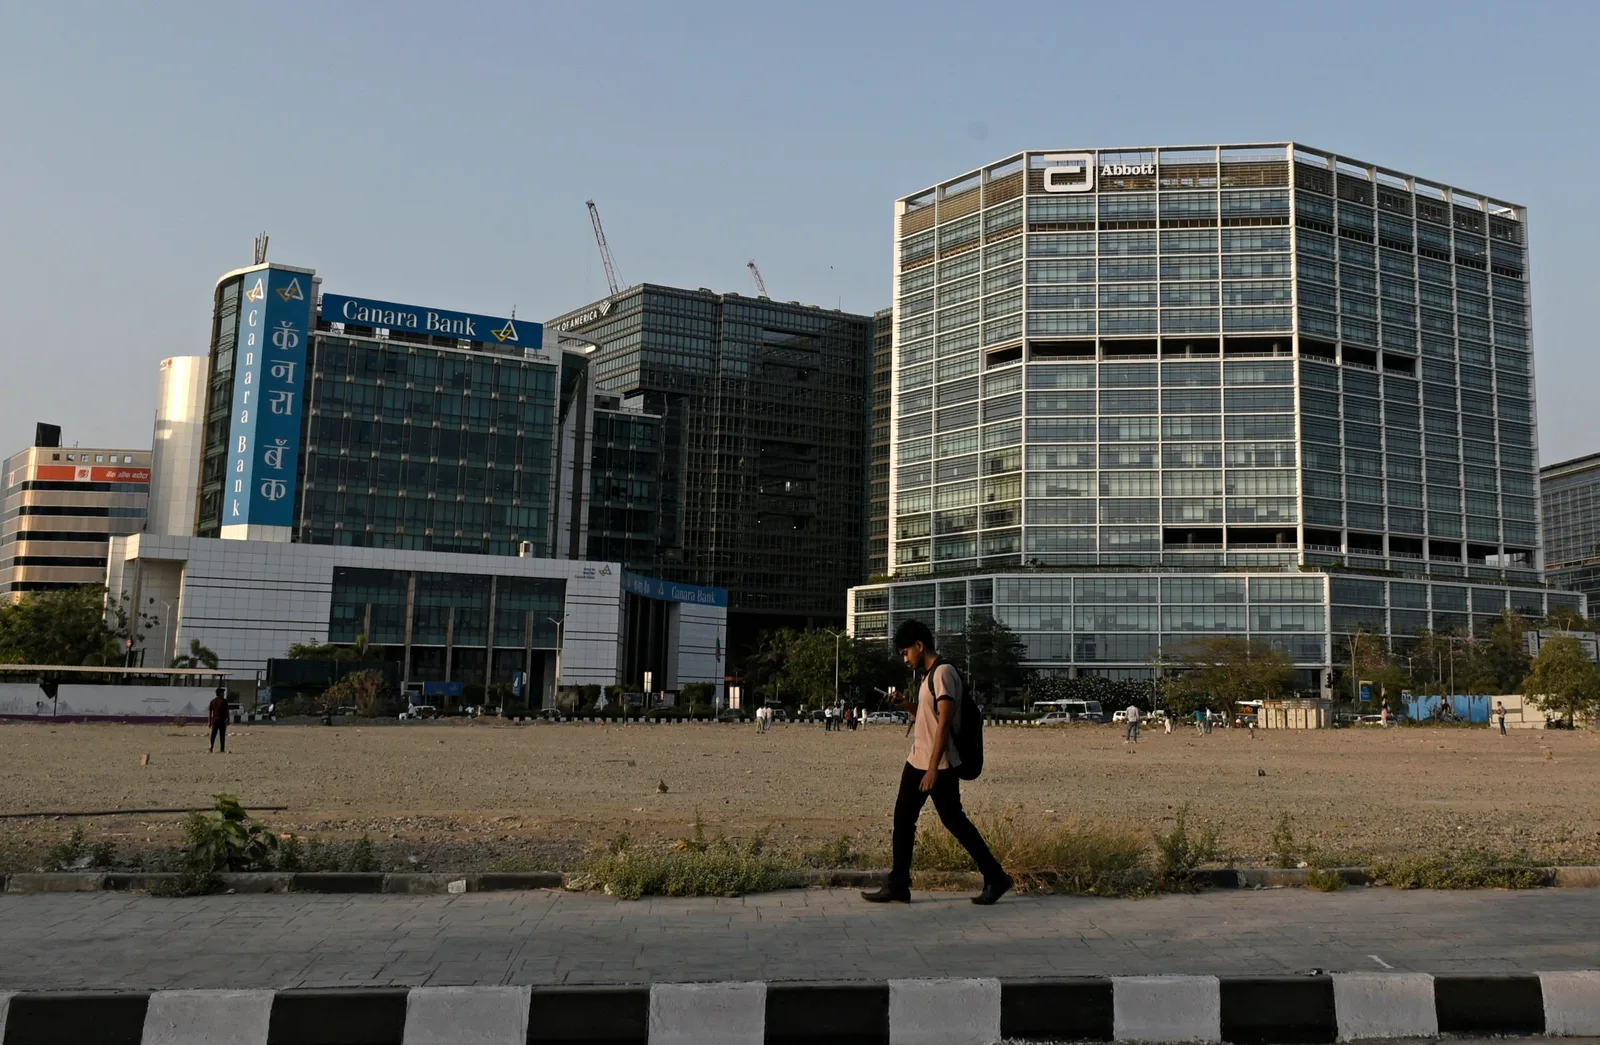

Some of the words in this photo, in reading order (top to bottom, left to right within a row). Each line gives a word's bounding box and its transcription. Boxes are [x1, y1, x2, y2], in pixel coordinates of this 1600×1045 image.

[1100, 163, 1155, 176] Abbott
[342, 300, 418, 329] Canara
[425, 311, 477, 337] Bank
[570, 310, 597, 327] AMERICA
[240, 309, 258, 424] Canara
[231, 435, 247, 517] Bank
[671, 585, 696, 601] Canara
[696, 589, 716, 604] Bank
